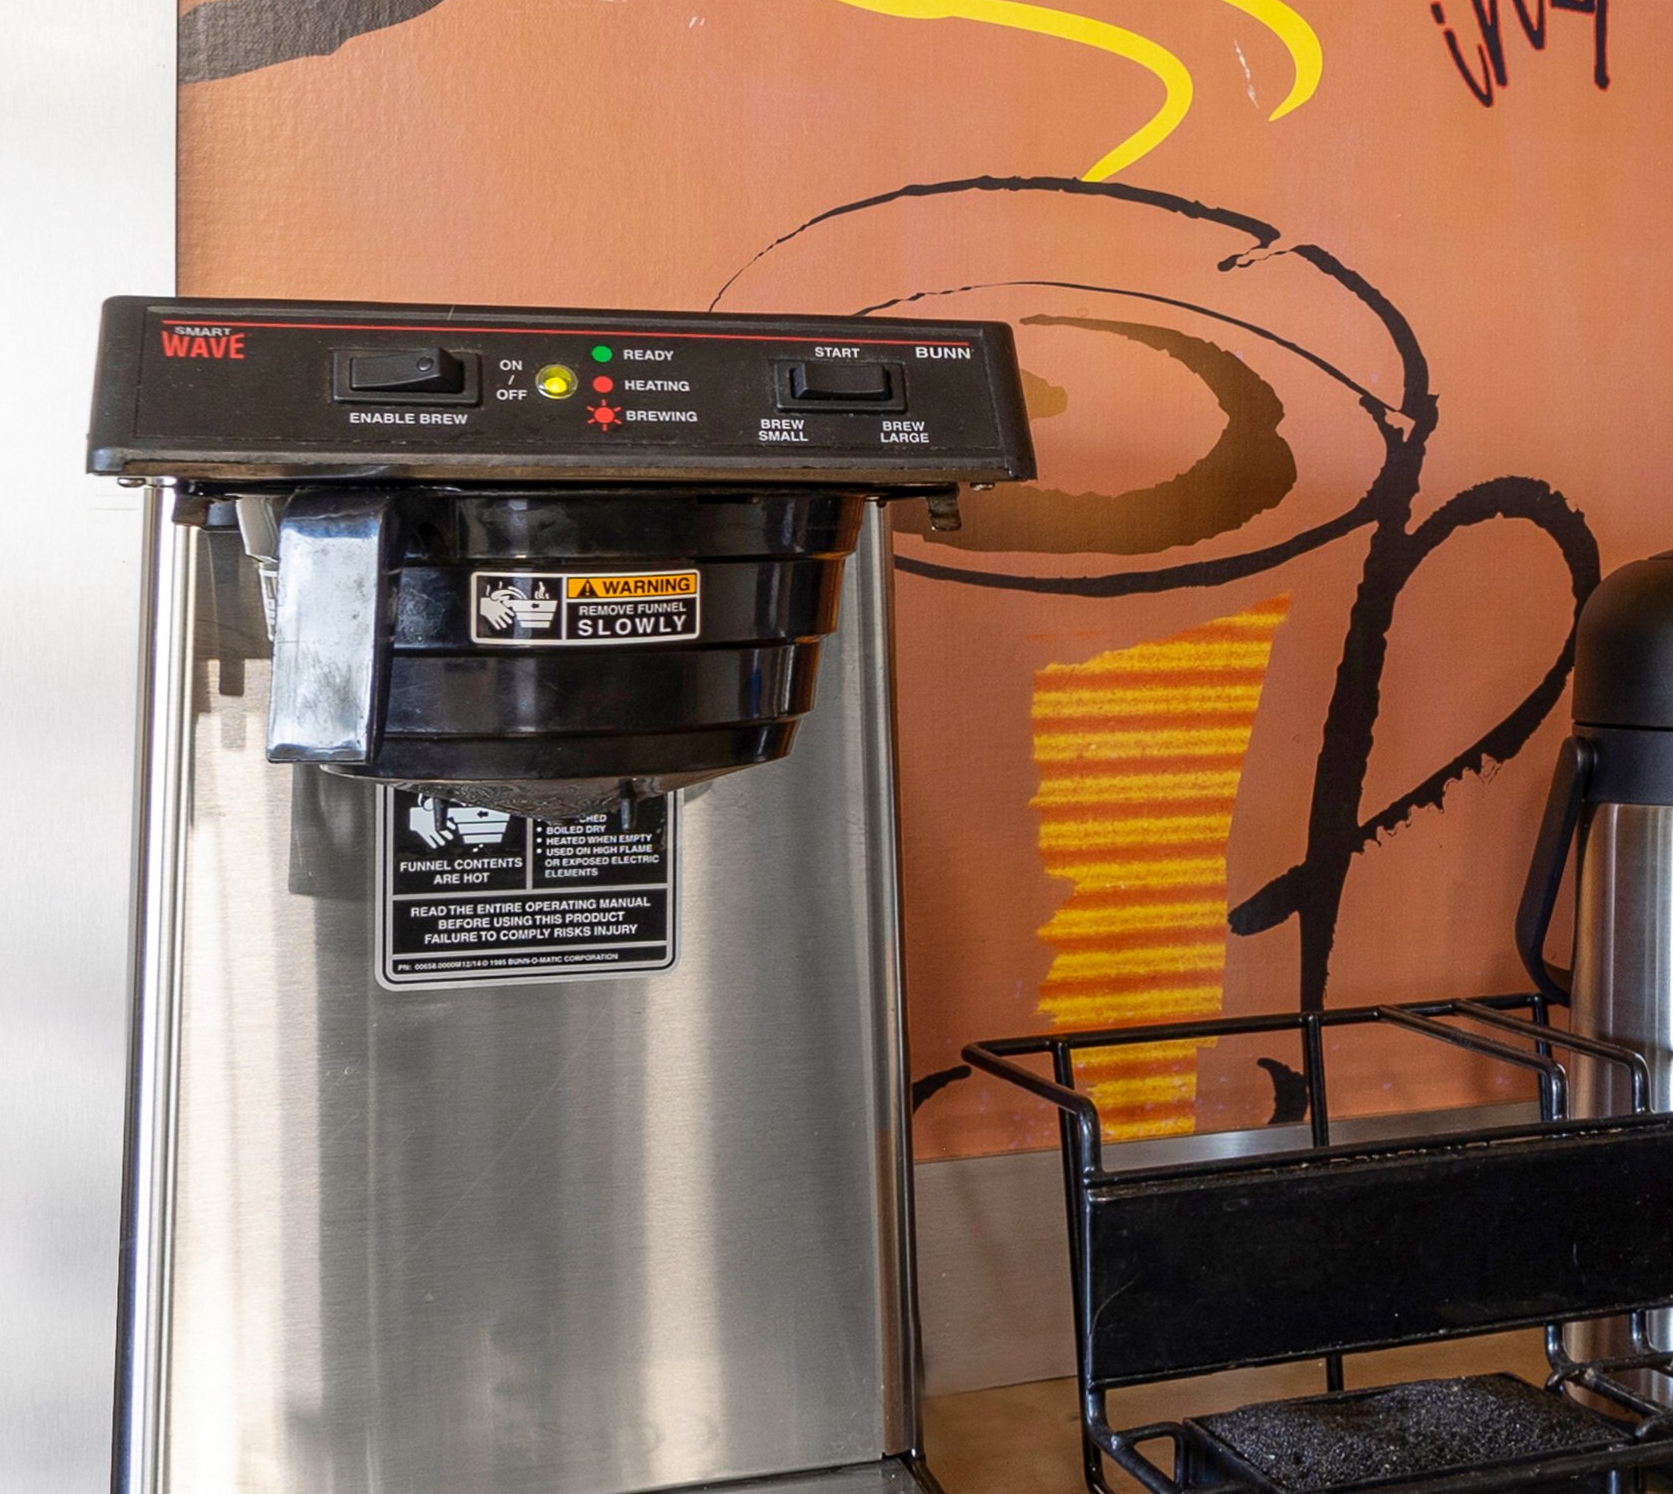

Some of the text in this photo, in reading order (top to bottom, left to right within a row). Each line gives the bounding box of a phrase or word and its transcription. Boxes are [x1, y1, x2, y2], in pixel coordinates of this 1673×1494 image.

[174, 326, 232, 337] SMART
[161, 330, 246, 359] WAVE
[623, 349, 675, 362] READY
[814, 346, 860, 359] START
[915, 346, 971, 360] BUNN
[499, 359, 523, 372] ON
[624, 379, 690, 392] HEATING
[496, 389, 527, 402] OFF
[349, 412, 469, 426] ENABLE BREW
[625, 410, 698, 423] BREWING
[760, 418, 804, 430] BREW
[881, 420, 925, 432] BREW
[758, 430, 809, 443] SMALL
[879, 431, 930, 444] LARGE
[602, 577, 691, 595] WARNING
[579, 601, 687, 617] REMOVE FUNNEL
[578, 614, 687, 637] SLOWLY
[546, 825, 606, 835] BOILED DRY
[546, 833, 652, 845] HEATED WHEN EMPTY
[546, 844, 652, 856] USED ON HIGH FLAME
[399, 857, 523, 872] FUNNEL CONTENTS
[545, 854, 660, 867] OR EXPOSED ELECTRIC
[433, 872, 490, 885] ARE HOT
[545, 868, 598, 878] ELEMENTS
[410, 896, 651, 918] READ THE ENTIRE OPERATING MANUAL
[438, 911, 625, 930] BEFORE USING THIS PRODUCT
[424, 923, 638, 944] FAILURE TO COMPLY RISKS INJURY
[564, 953, 619, 963] CORPORATION
